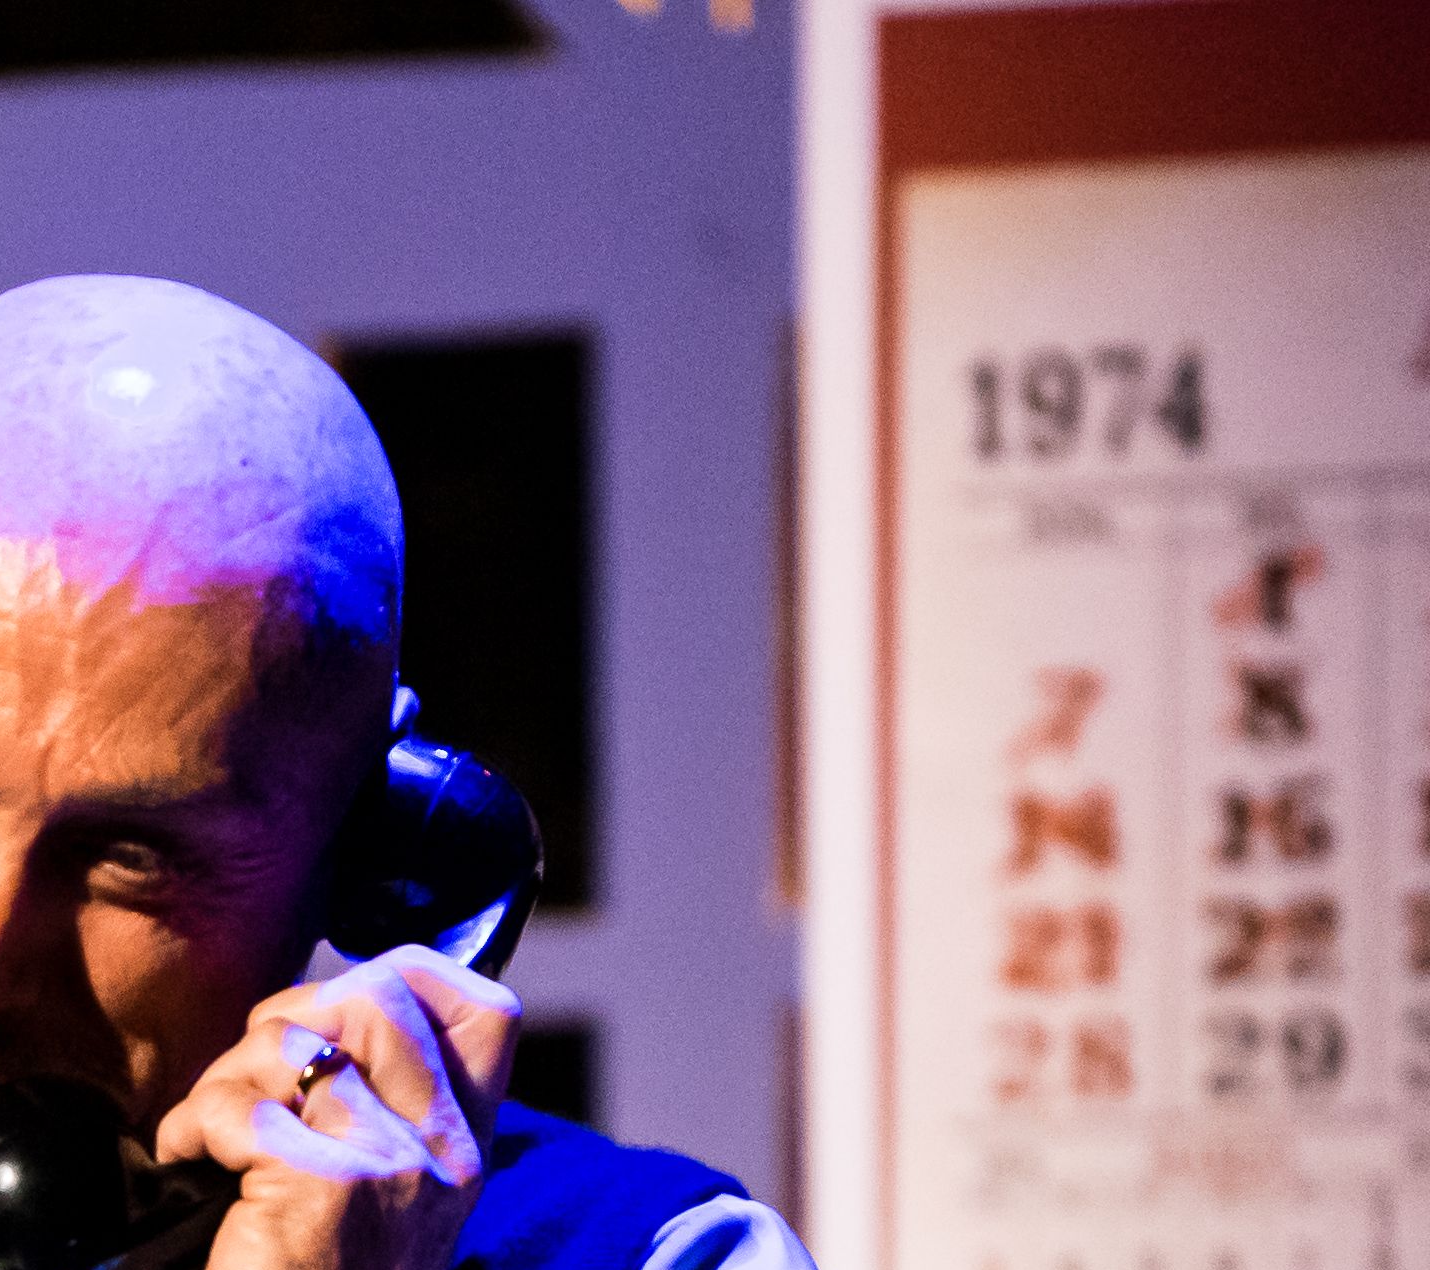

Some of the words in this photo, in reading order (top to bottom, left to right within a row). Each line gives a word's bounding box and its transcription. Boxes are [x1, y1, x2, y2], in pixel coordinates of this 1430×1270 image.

[967, 344, 1208, 464] 1974
[1000, 902, 1122, 988] 21
[992, 1014, 1136, 1102] 28
[1203, 1006, 1349, 1098] 29
